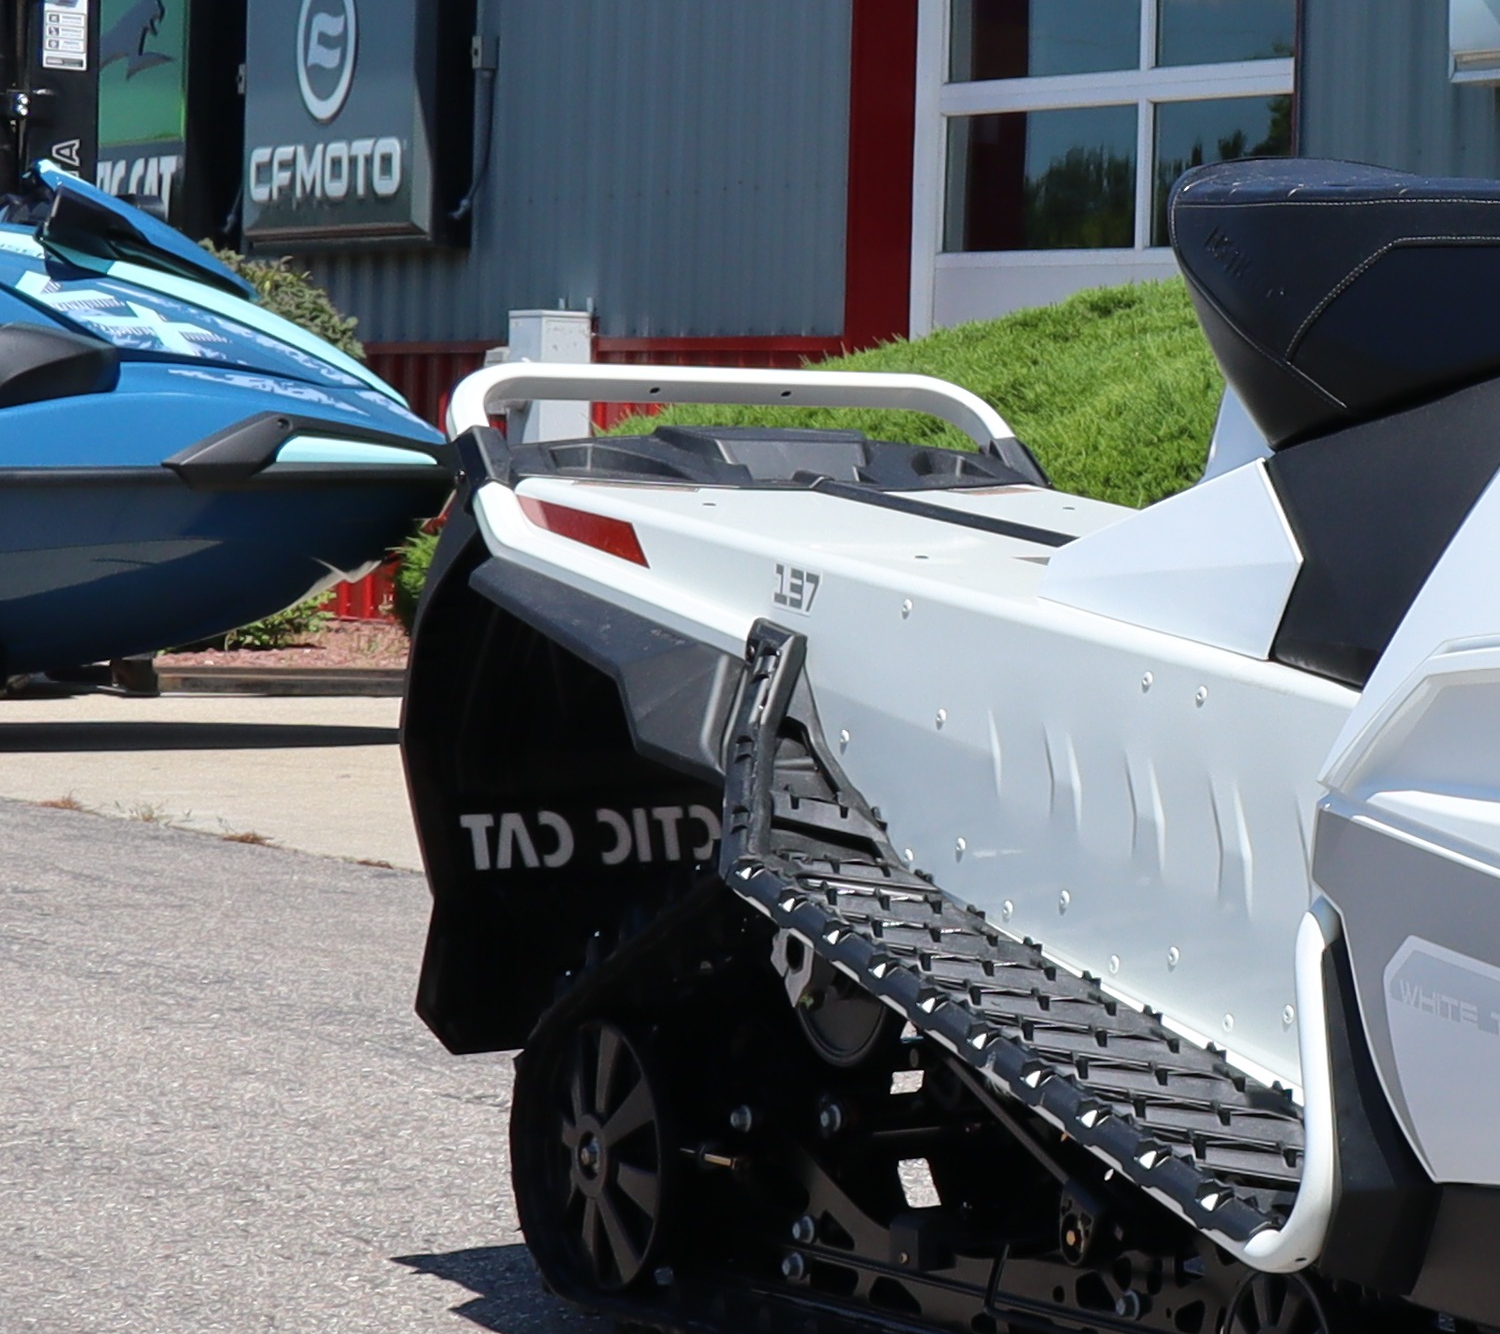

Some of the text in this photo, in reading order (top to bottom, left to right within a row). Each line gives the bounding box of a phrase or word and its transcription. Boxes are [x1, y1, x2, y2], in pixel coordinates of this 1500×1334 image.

[251, 137, 402, 203] CFMOTO
[773, 563, 821, 613] 137
[1398, 978, 1479, 1025] WHITE
